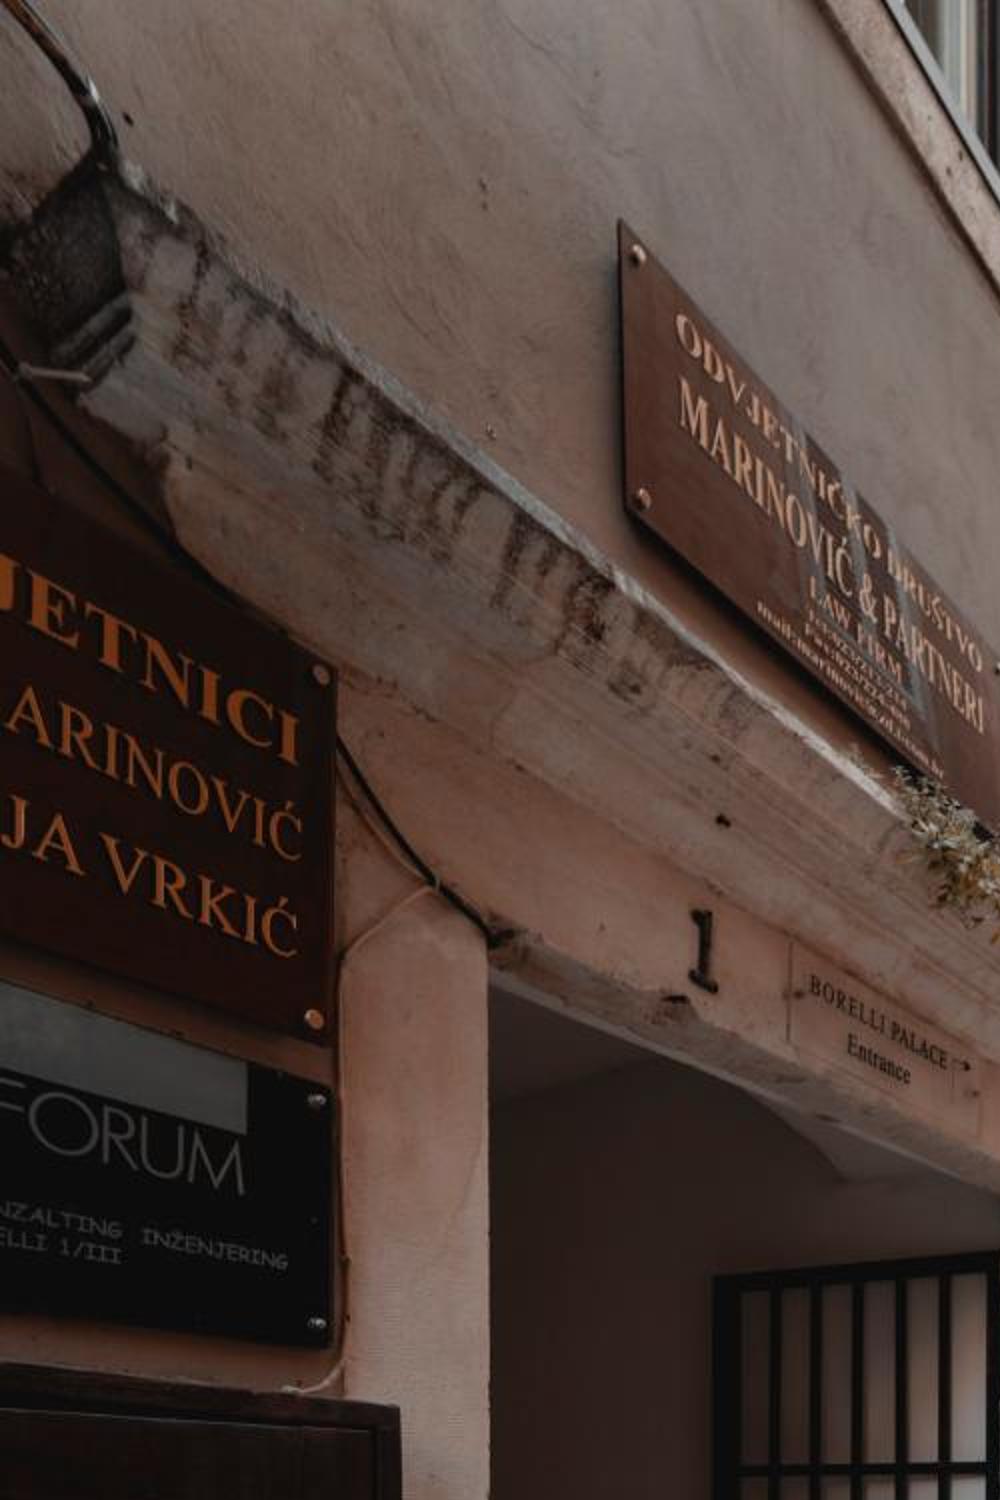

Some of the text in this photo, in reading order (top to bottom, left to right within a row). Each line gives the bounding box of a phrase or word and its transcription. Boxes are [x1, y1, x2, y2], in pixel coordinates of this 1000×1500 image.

[678, 376, 985, 735] MARINOVIĆ & PARTNERI
[809, 575, 903, 685] LAW FIRM
[100, 831, 298, 958] VRKIĆ
[688, 908, 718, 994] 1
[810, 973, 948, 1071] BORELLI PALACE
[847, 1032, 912, 1085] Entrance
